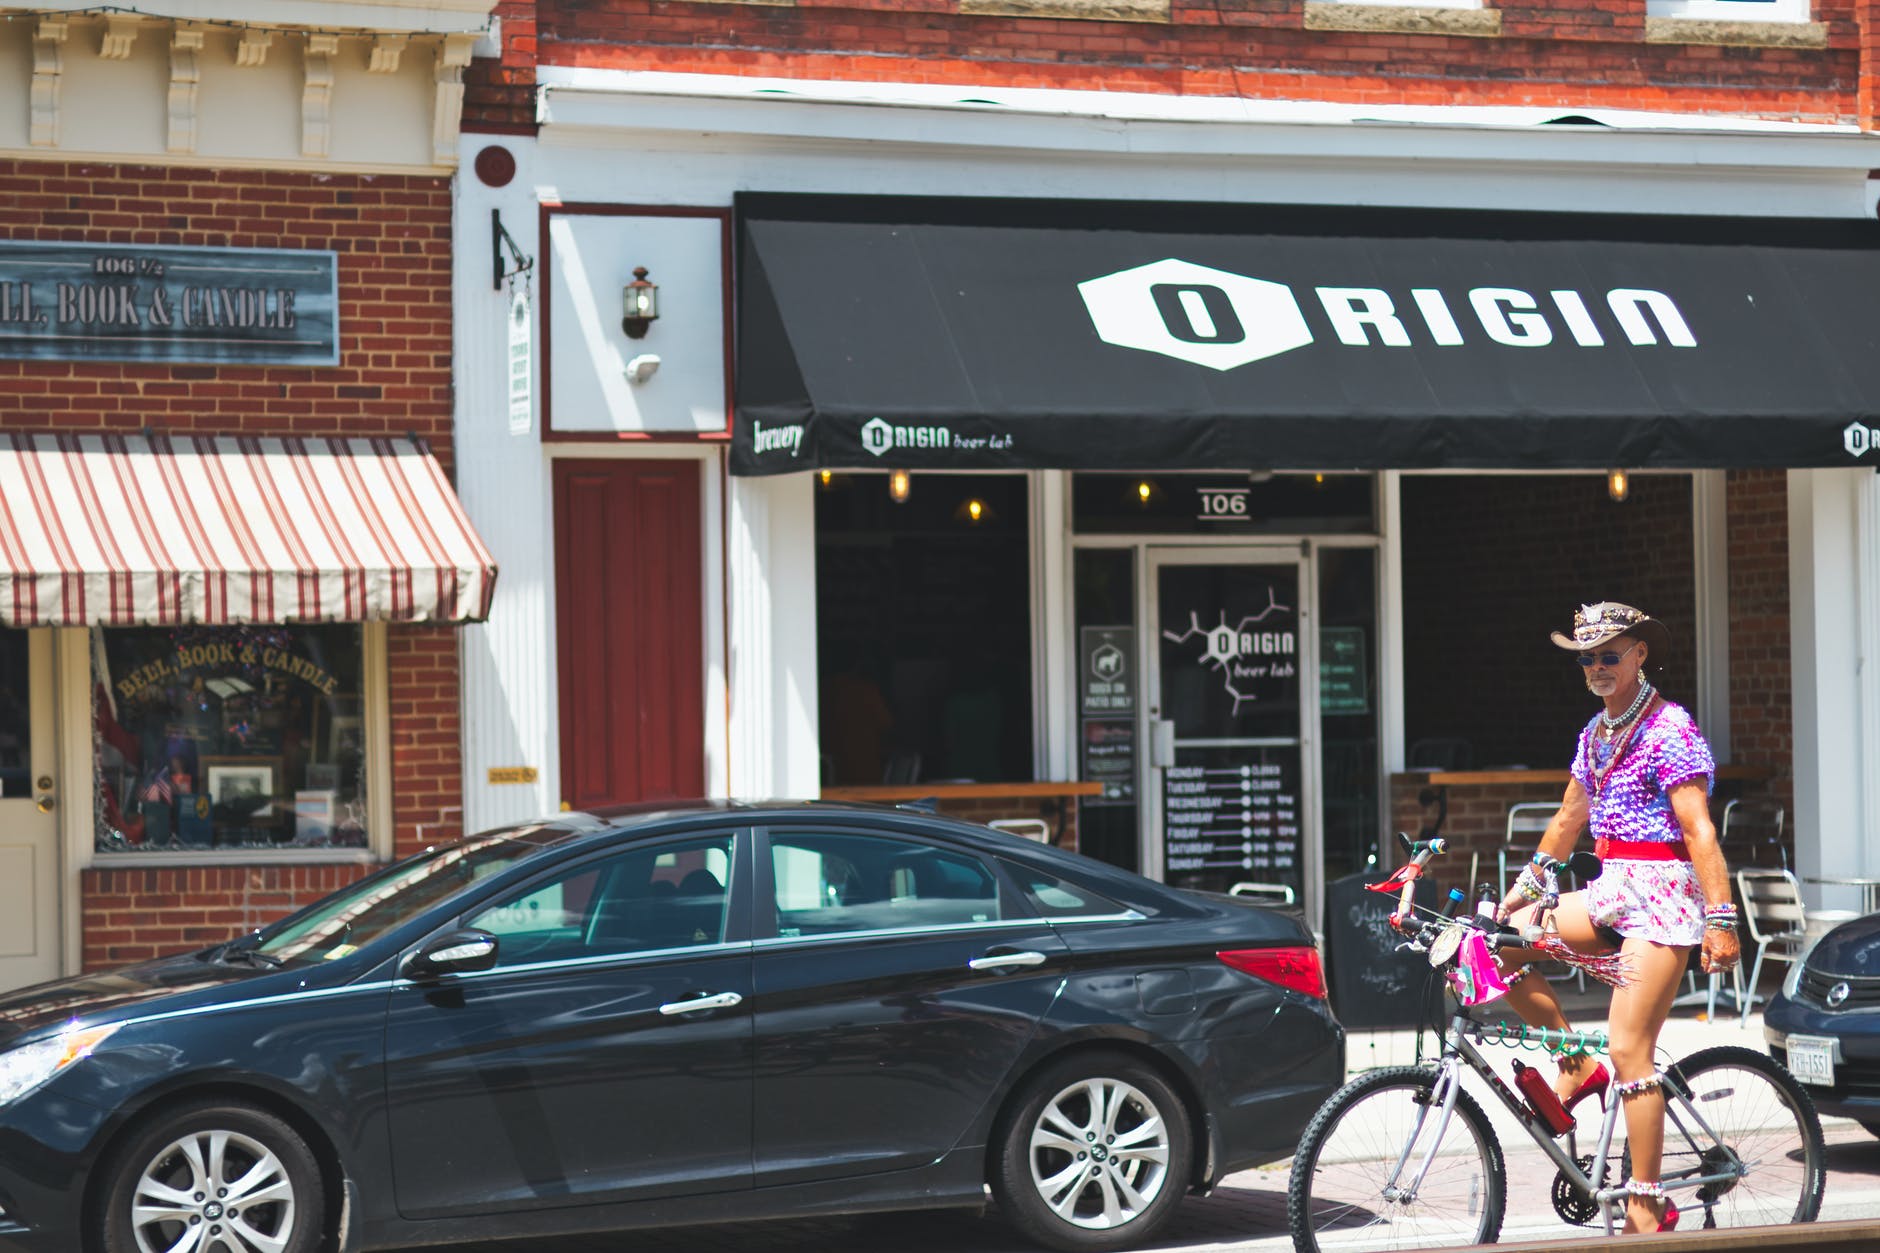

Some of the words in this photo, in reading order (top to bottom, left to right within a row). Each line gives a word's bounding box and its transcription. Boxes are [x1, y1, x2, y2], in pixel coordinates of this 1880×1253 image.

[94, 256, 135, 273] 106
[57, 282, 140, 326] BOOK
[148, 286, 173, 326] &
[181, 286, 296, 329] CANDLE
[1077, 258, 1697, 371] ORIGIN
[754, 420, 804, 457] brewery
[860, 416, 950, 457] ORIGIN
[953, 433, 987, 449] beer
[989, 433, 1013, 449] lab
[1201, 494, 1247, 514] 106
[1207, 624, 1294, 662] ORIGIN
[176, 644, 235, 670] BOOK
[239, 645, 258, 664] &
[262, 647, 339, 696] CANDLE
[1233, 662, 1268, 678] beer
[1270, 662, 1295, 678] lab
[1166, 766, 1204, 779] MONDAY
[1251, 765, 1281, 776] CLOSED
[1167, 781, 1207, 794] TUESDAY
[1251, 780, 1281, 790] CLOSED
[1167, 797, 1223, 809] WEDNESDAY
[1167, 811, 1214, 824] THURSDAY
[1167, 826, 1200, 839] FRIDAY
[1168, 842, 1214, 855] SATURDAY
[1168, 857, 1204, 870] SUNDAY
